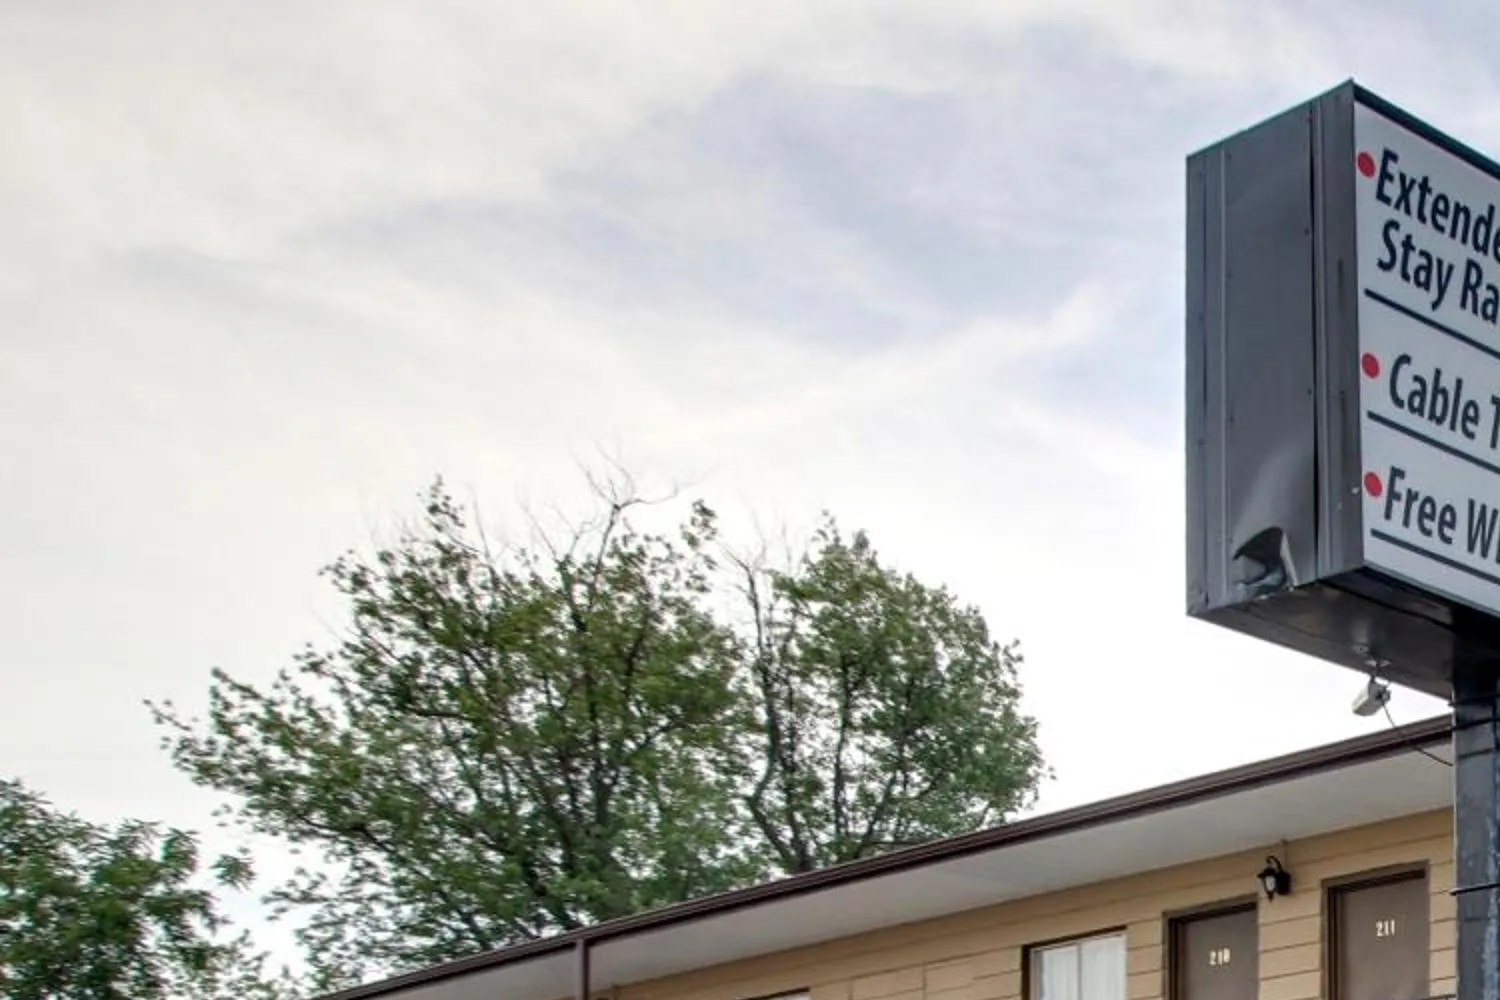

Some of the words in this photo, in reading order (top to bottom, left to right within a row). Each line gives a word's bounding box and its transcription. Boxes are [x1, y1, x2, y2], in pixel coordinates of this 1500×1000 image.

[1377, 220, 1453, 311] Stay
[1389, 354, 1479, 442] Cable
[1384, 466, 1456, 545] Free
